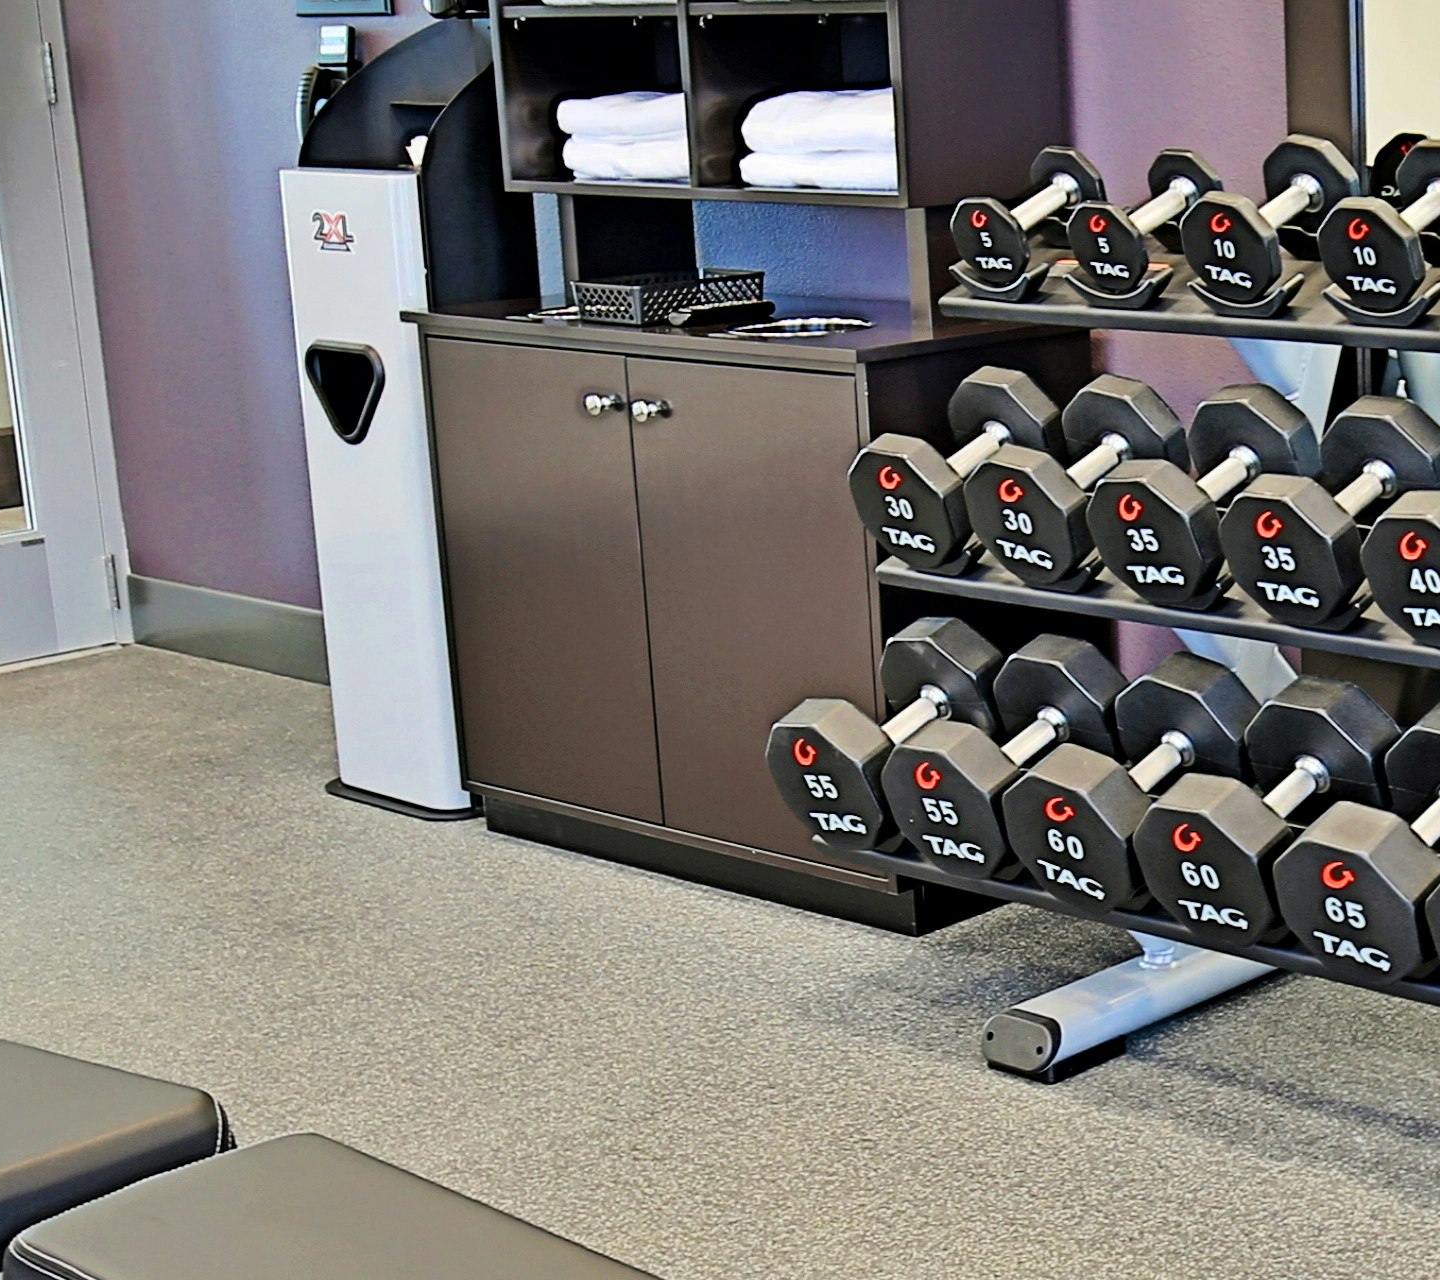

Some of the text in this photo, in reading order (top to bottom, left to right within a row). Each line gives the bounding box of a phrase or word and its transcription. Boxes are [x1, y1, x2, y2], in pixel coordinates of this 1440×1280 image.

[312, 212, 355, 245] 2XL
[979, 231, 993, 248] 5
[1097, 237, 1110, 254] 5
[1213, 238, 1236, 259] 10
[1353, 246, 1377, 266] 10
[975, 256, 1013, 271] TAG
[1089, 261, 1130, 279] TAG
[1204, 264, 1253, 289] TAG
[1343, 275, 1397, 296] TAG
[884, 495, 914, 520] 30
[1002, 508, 1033, 535] 30
[881, 526, 935, 554] TAG
[1126, 528, 1159, 552] 35
[994, 539, 1053, 571] TAG
[1261, 545, 1296, 572] 35
[1126, 565, 1185, 586] TAG
[1255, 581, 1320, 609] TAG
[803, 774, 839, 799] 55
[809, 812, 867, 835] TAG
[922, 797, 959, 826] 55
[922, 834, 985, 864] TAG
[1047, 829, 1084, 860] 60
[1035, 859, 1105, 901] TAG
[1181, 861, 1220, 890] 60
[1177, 899, 1249, 930] TAG
[1325, 896, 1366, 929] 65
[1313, 930, 1391, 972] TAG
